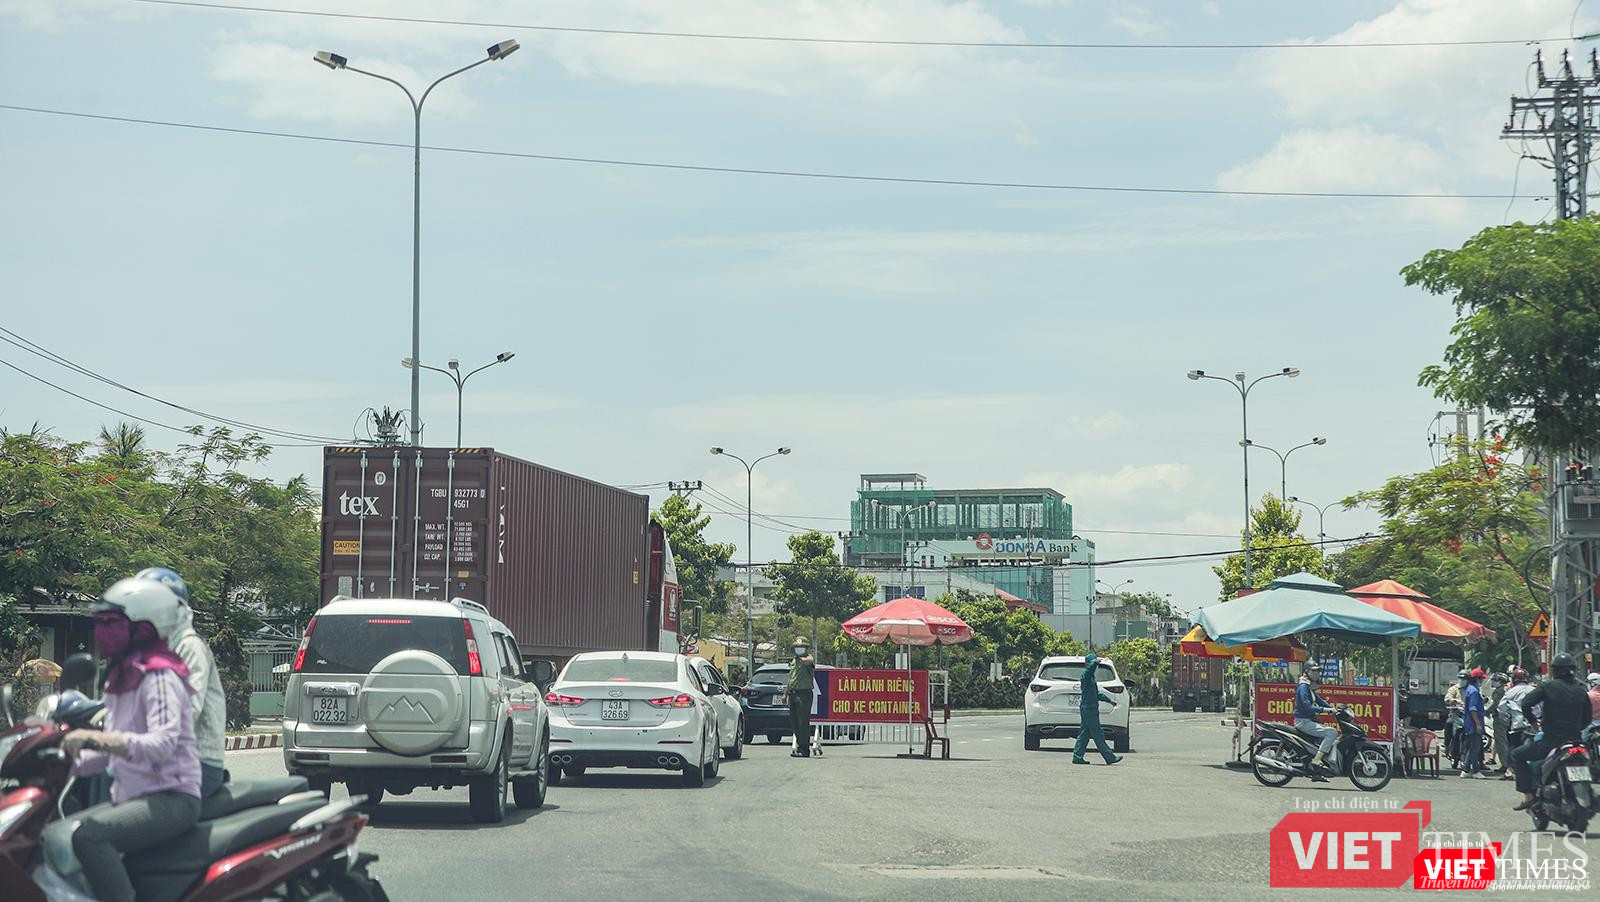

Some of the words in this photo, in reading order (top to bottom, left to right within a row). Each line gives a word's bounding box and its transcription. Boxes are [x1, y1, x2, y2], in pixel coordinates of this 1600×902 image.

[430, 488, 447, 498] TGBU
[454, 489, 478, 498] 932773
[338, 490, 380, 516] tex
[454, 500, 470, 508] 45G1
[1049, 543, 1078, 552] Bank
[838, 676, 856, 692] LÀN
[860, 676, 884, 692] DÀNH
[887, 677, 916, 693] RIÊNG
[320, 698, 339, 710] 82A
[608, 700, 623, 709] 43A
[832, 701, 850, 714] CHO
[854, 701, 866, 714] XE
[868, 701, 920, 714] CONTAINER
[1268, 698, 1296, 715] CHỐ
[312, 710, 346, 722] 022.32
[602, 710, 628, 719] 326.69
[1378, 724, 1387, 734] 19
